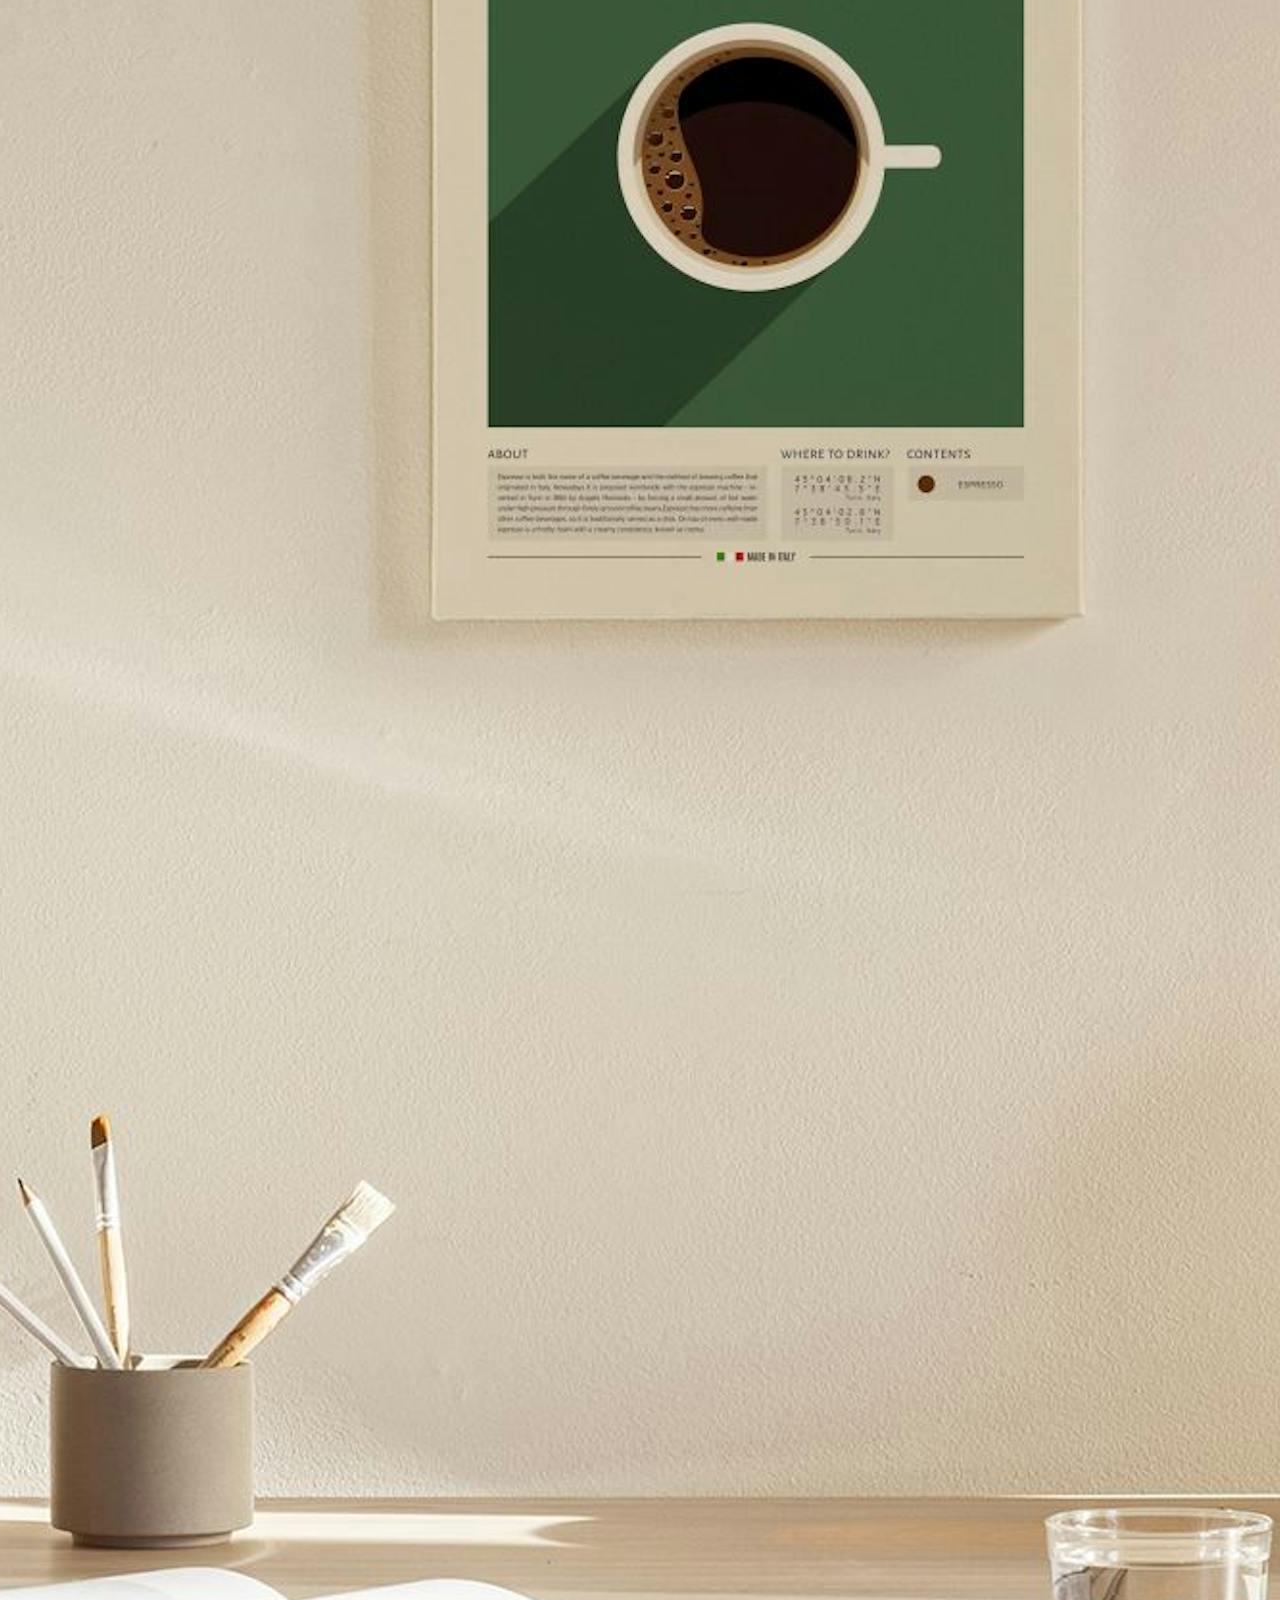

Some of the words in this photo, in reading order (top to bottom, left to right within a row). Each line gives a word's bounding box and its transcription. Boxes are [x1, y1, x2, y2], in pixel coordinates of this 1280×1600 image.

[488, 449, 529, 460] ABOUT
[780, 448, 825, 459] WHERE
[828, 448, 844, 459] TO
[846, 448, 891, 459] DRINK?
[906, 448, 972, 460] CONTENTS
